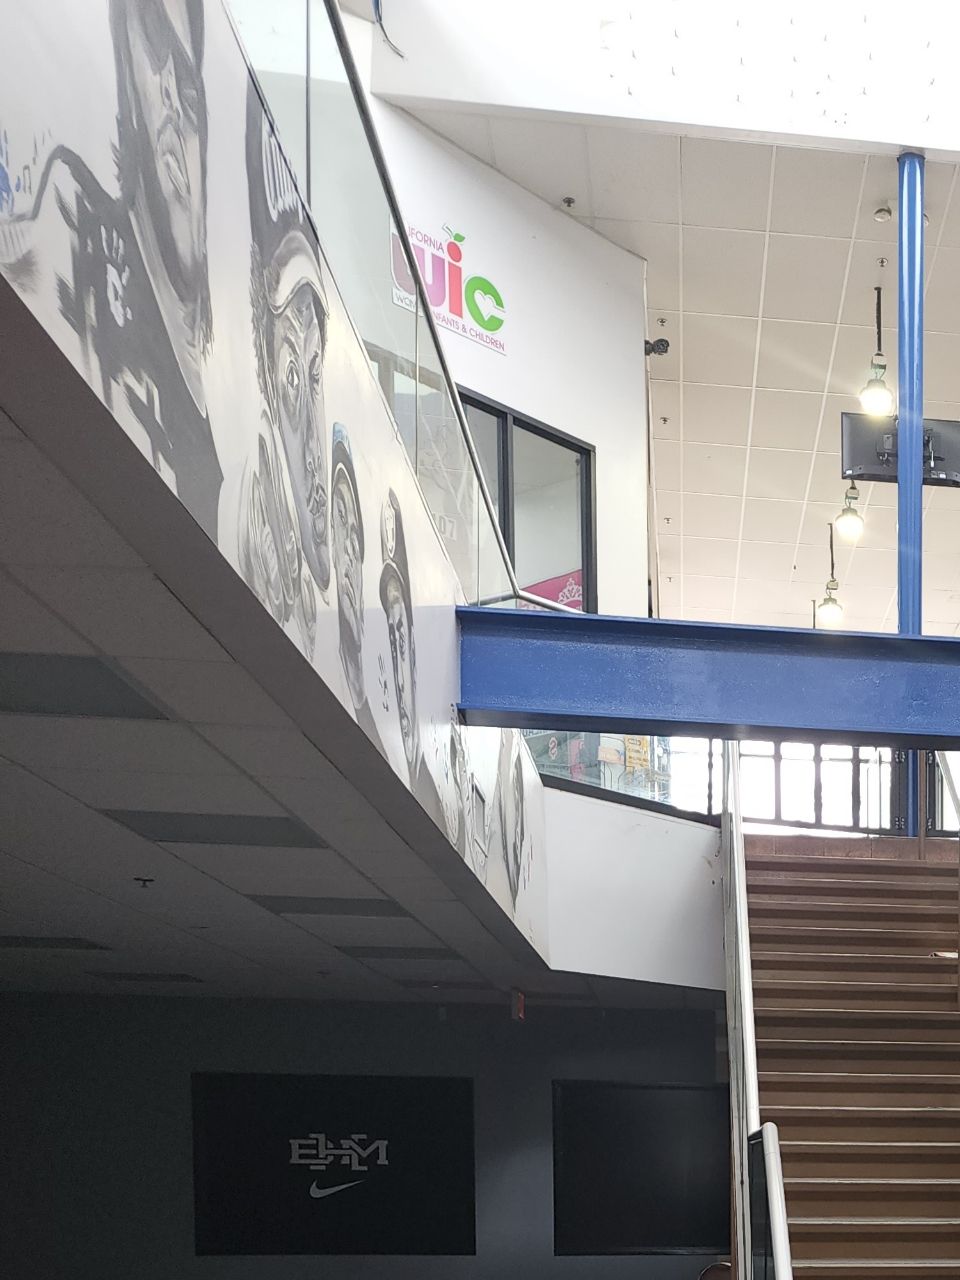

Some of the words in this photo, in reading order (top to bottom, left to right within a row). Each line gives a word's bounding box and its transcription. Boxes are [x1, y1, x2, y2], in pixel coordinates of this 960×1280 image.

[432, 310, 461, 331] NFANTS
[461, 323, 468, 334] &
[468, 327, 506, 352] CHILDREN
